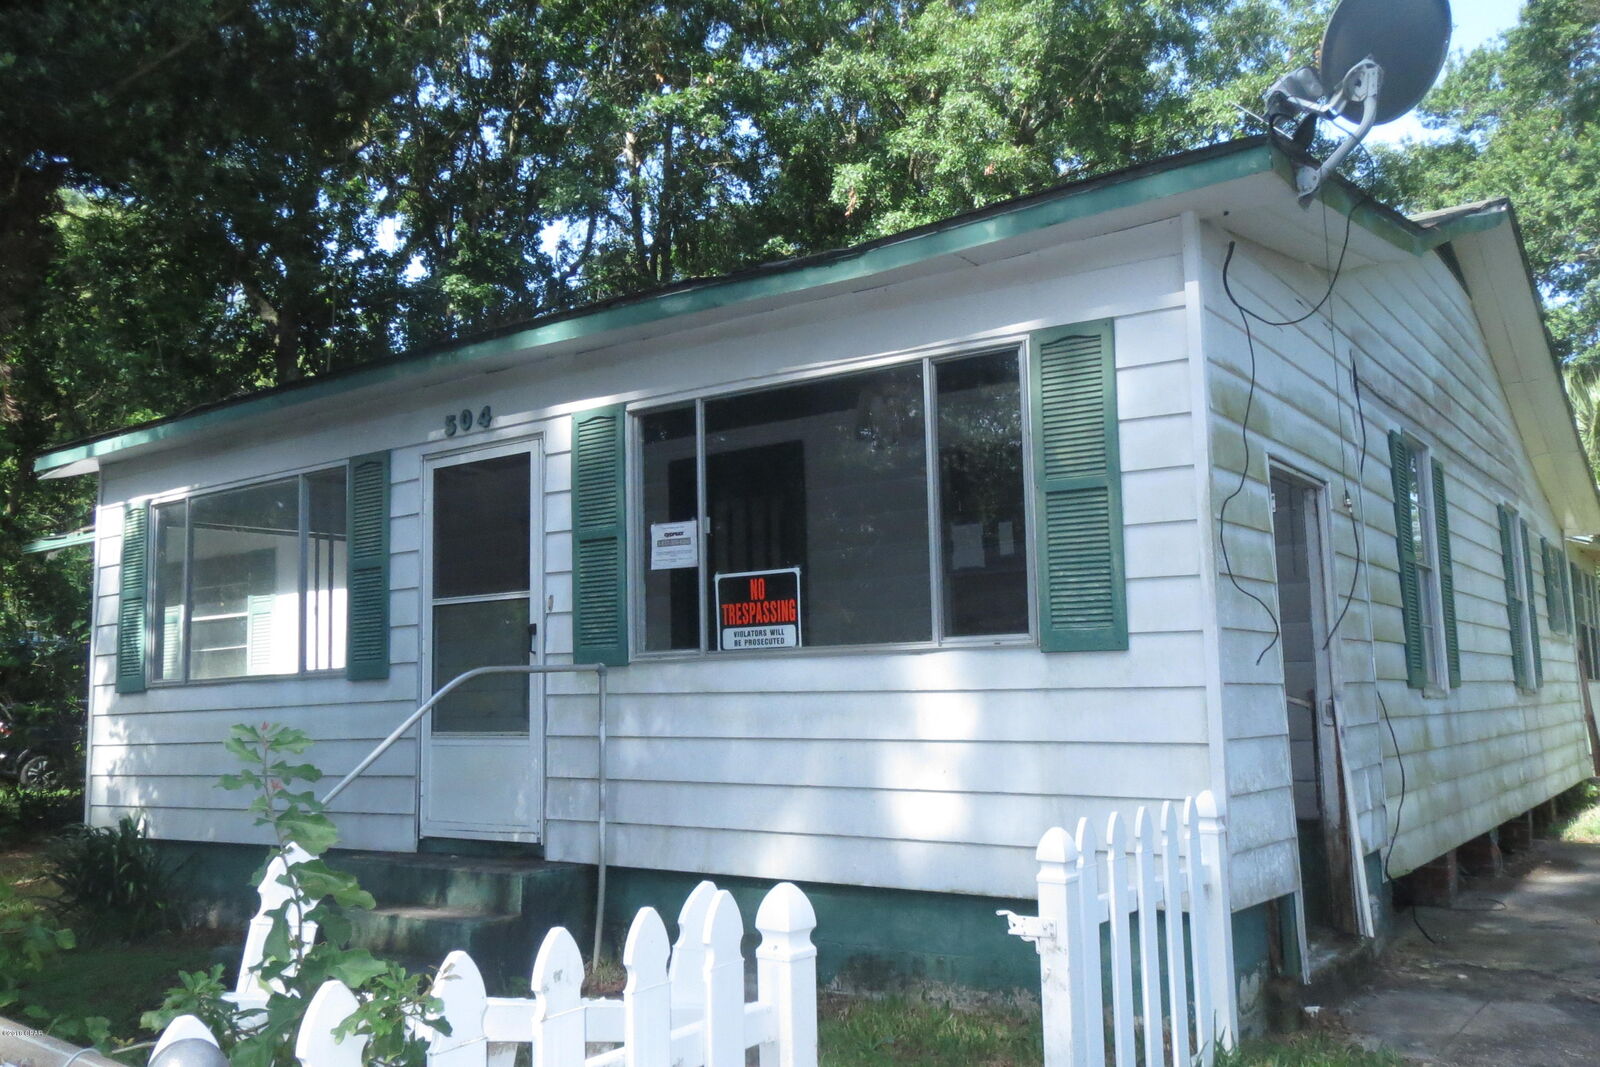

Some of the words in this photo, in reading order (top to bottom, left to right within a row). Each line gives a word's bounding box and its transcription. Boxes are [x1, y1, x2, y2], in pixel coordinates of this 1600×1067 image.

[445, 405, 492, 437] 504
[750, 578, 765, 600] NO
[722, 598, 796, 625] TRESPASSING
[733, 629, 767, 638] VIOLATORS
[769, 628, 785, 636] WILL
[733, 639, 742, 647] BE
[744, 637, 785, 646] PROSECUTED
